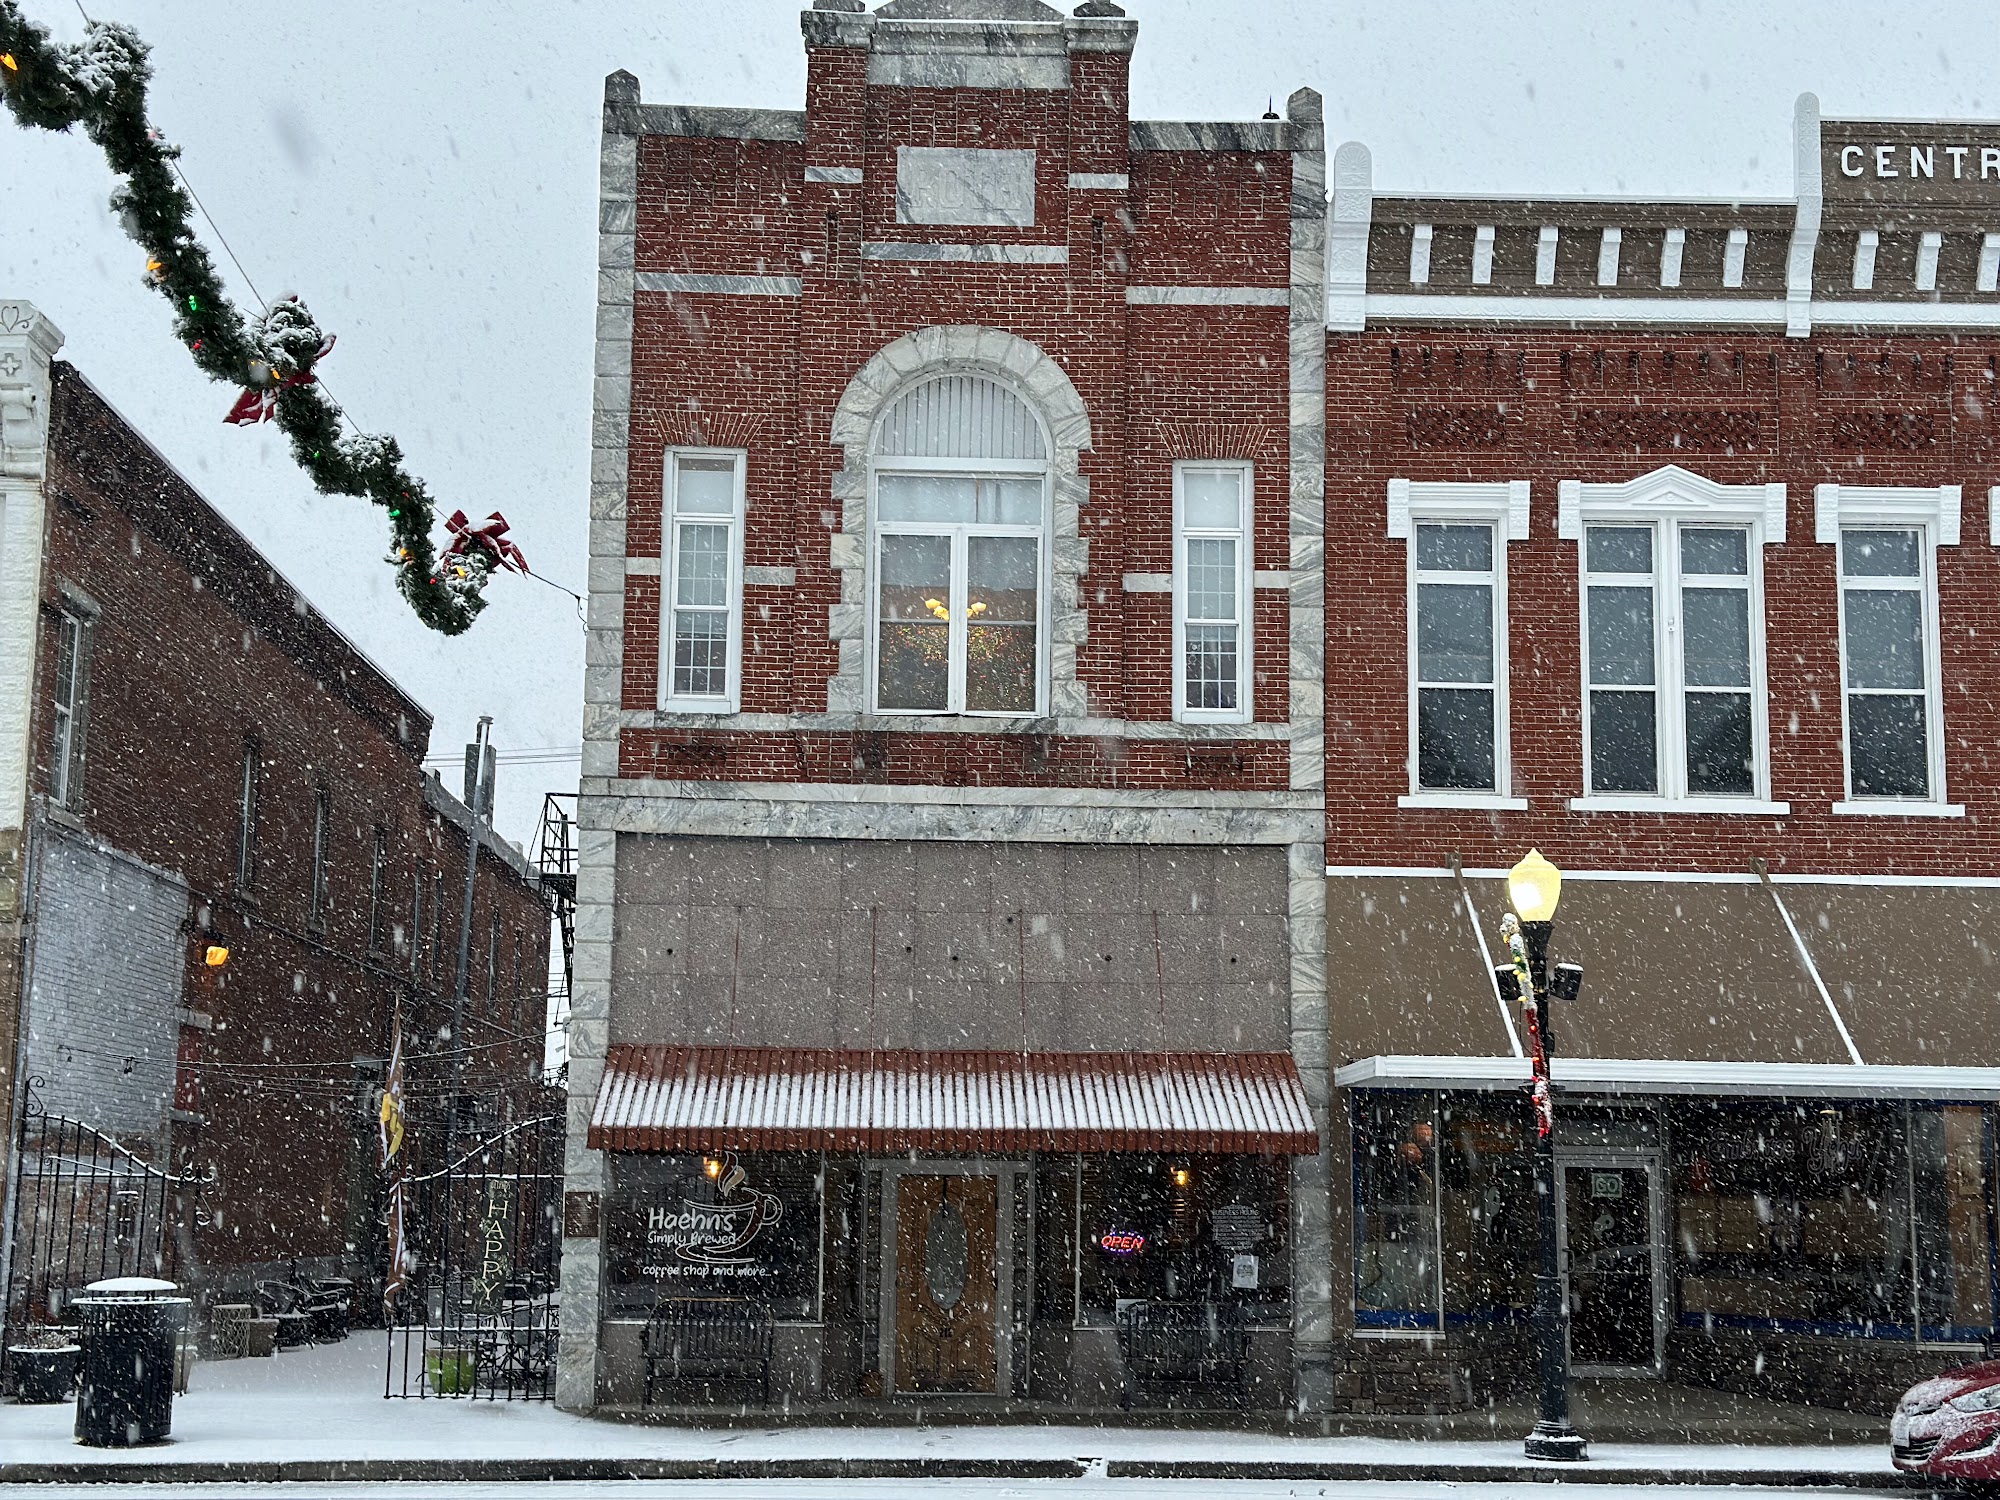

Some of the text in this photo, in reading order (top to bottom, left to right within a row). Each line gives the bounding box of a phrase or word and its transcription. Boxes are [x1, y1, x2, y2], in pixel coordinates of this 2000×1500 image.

[647, 1231, 736, 1247] Simply Brewed
[1101, 1235, 1144, 1250] OPEN
[481, 1199, 509, 1301] HAPPY
[642, 1266, 679, 1278] coffee
[683, 1265, 709, 1278] shop
[712, 1265, 734, 1276] and
